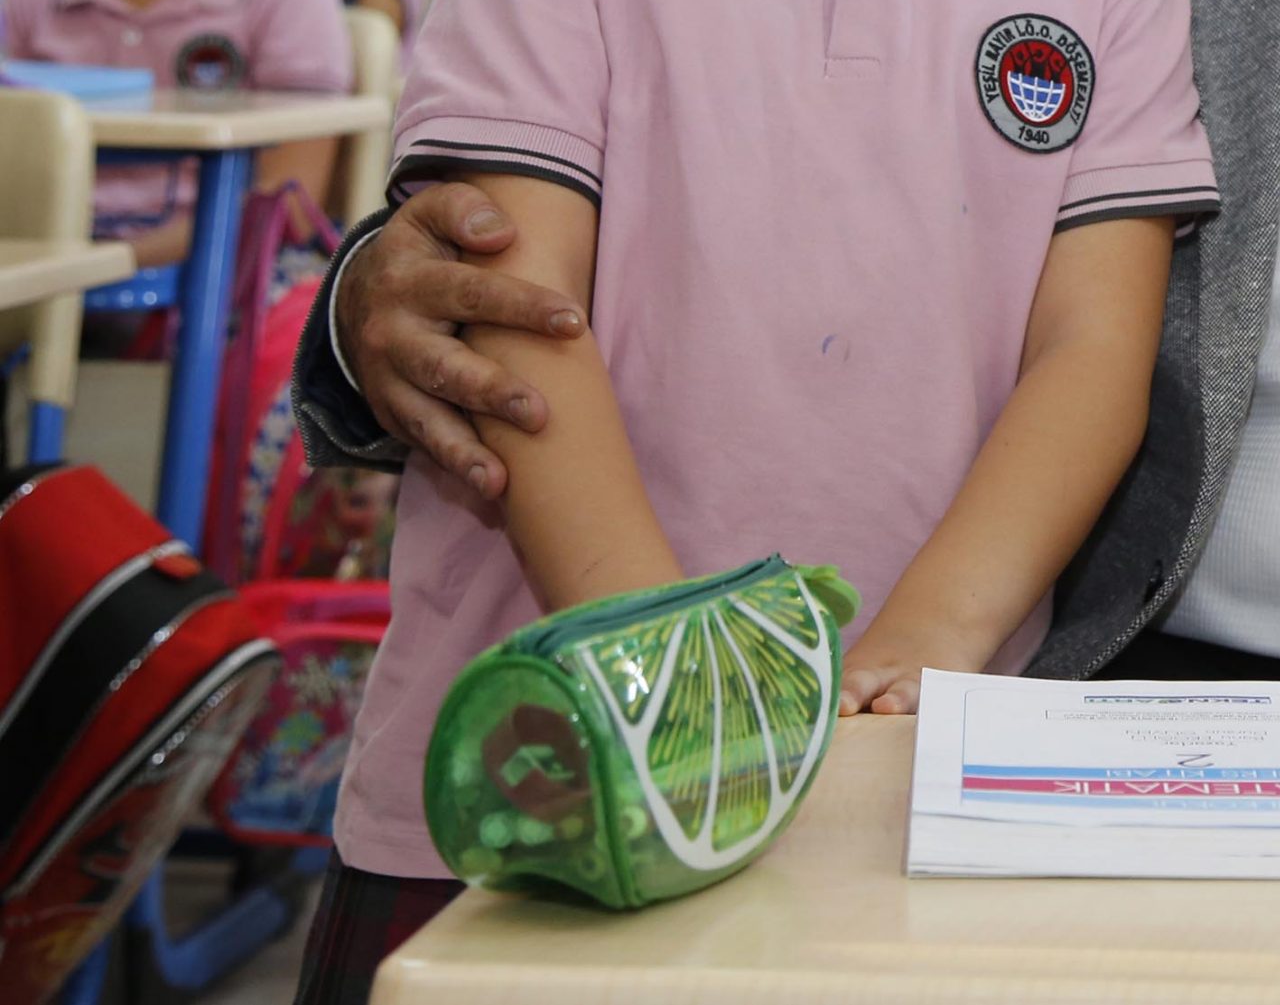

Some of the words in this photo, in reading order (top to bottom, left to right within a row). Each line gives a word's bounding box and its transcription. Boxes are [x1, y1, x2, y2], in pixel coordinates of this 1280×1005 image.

[985, 28, 1016, 61] BAYIR
[1018, 125, 1050, 145] 1940
[1176, 753, 1214, 768] 2
